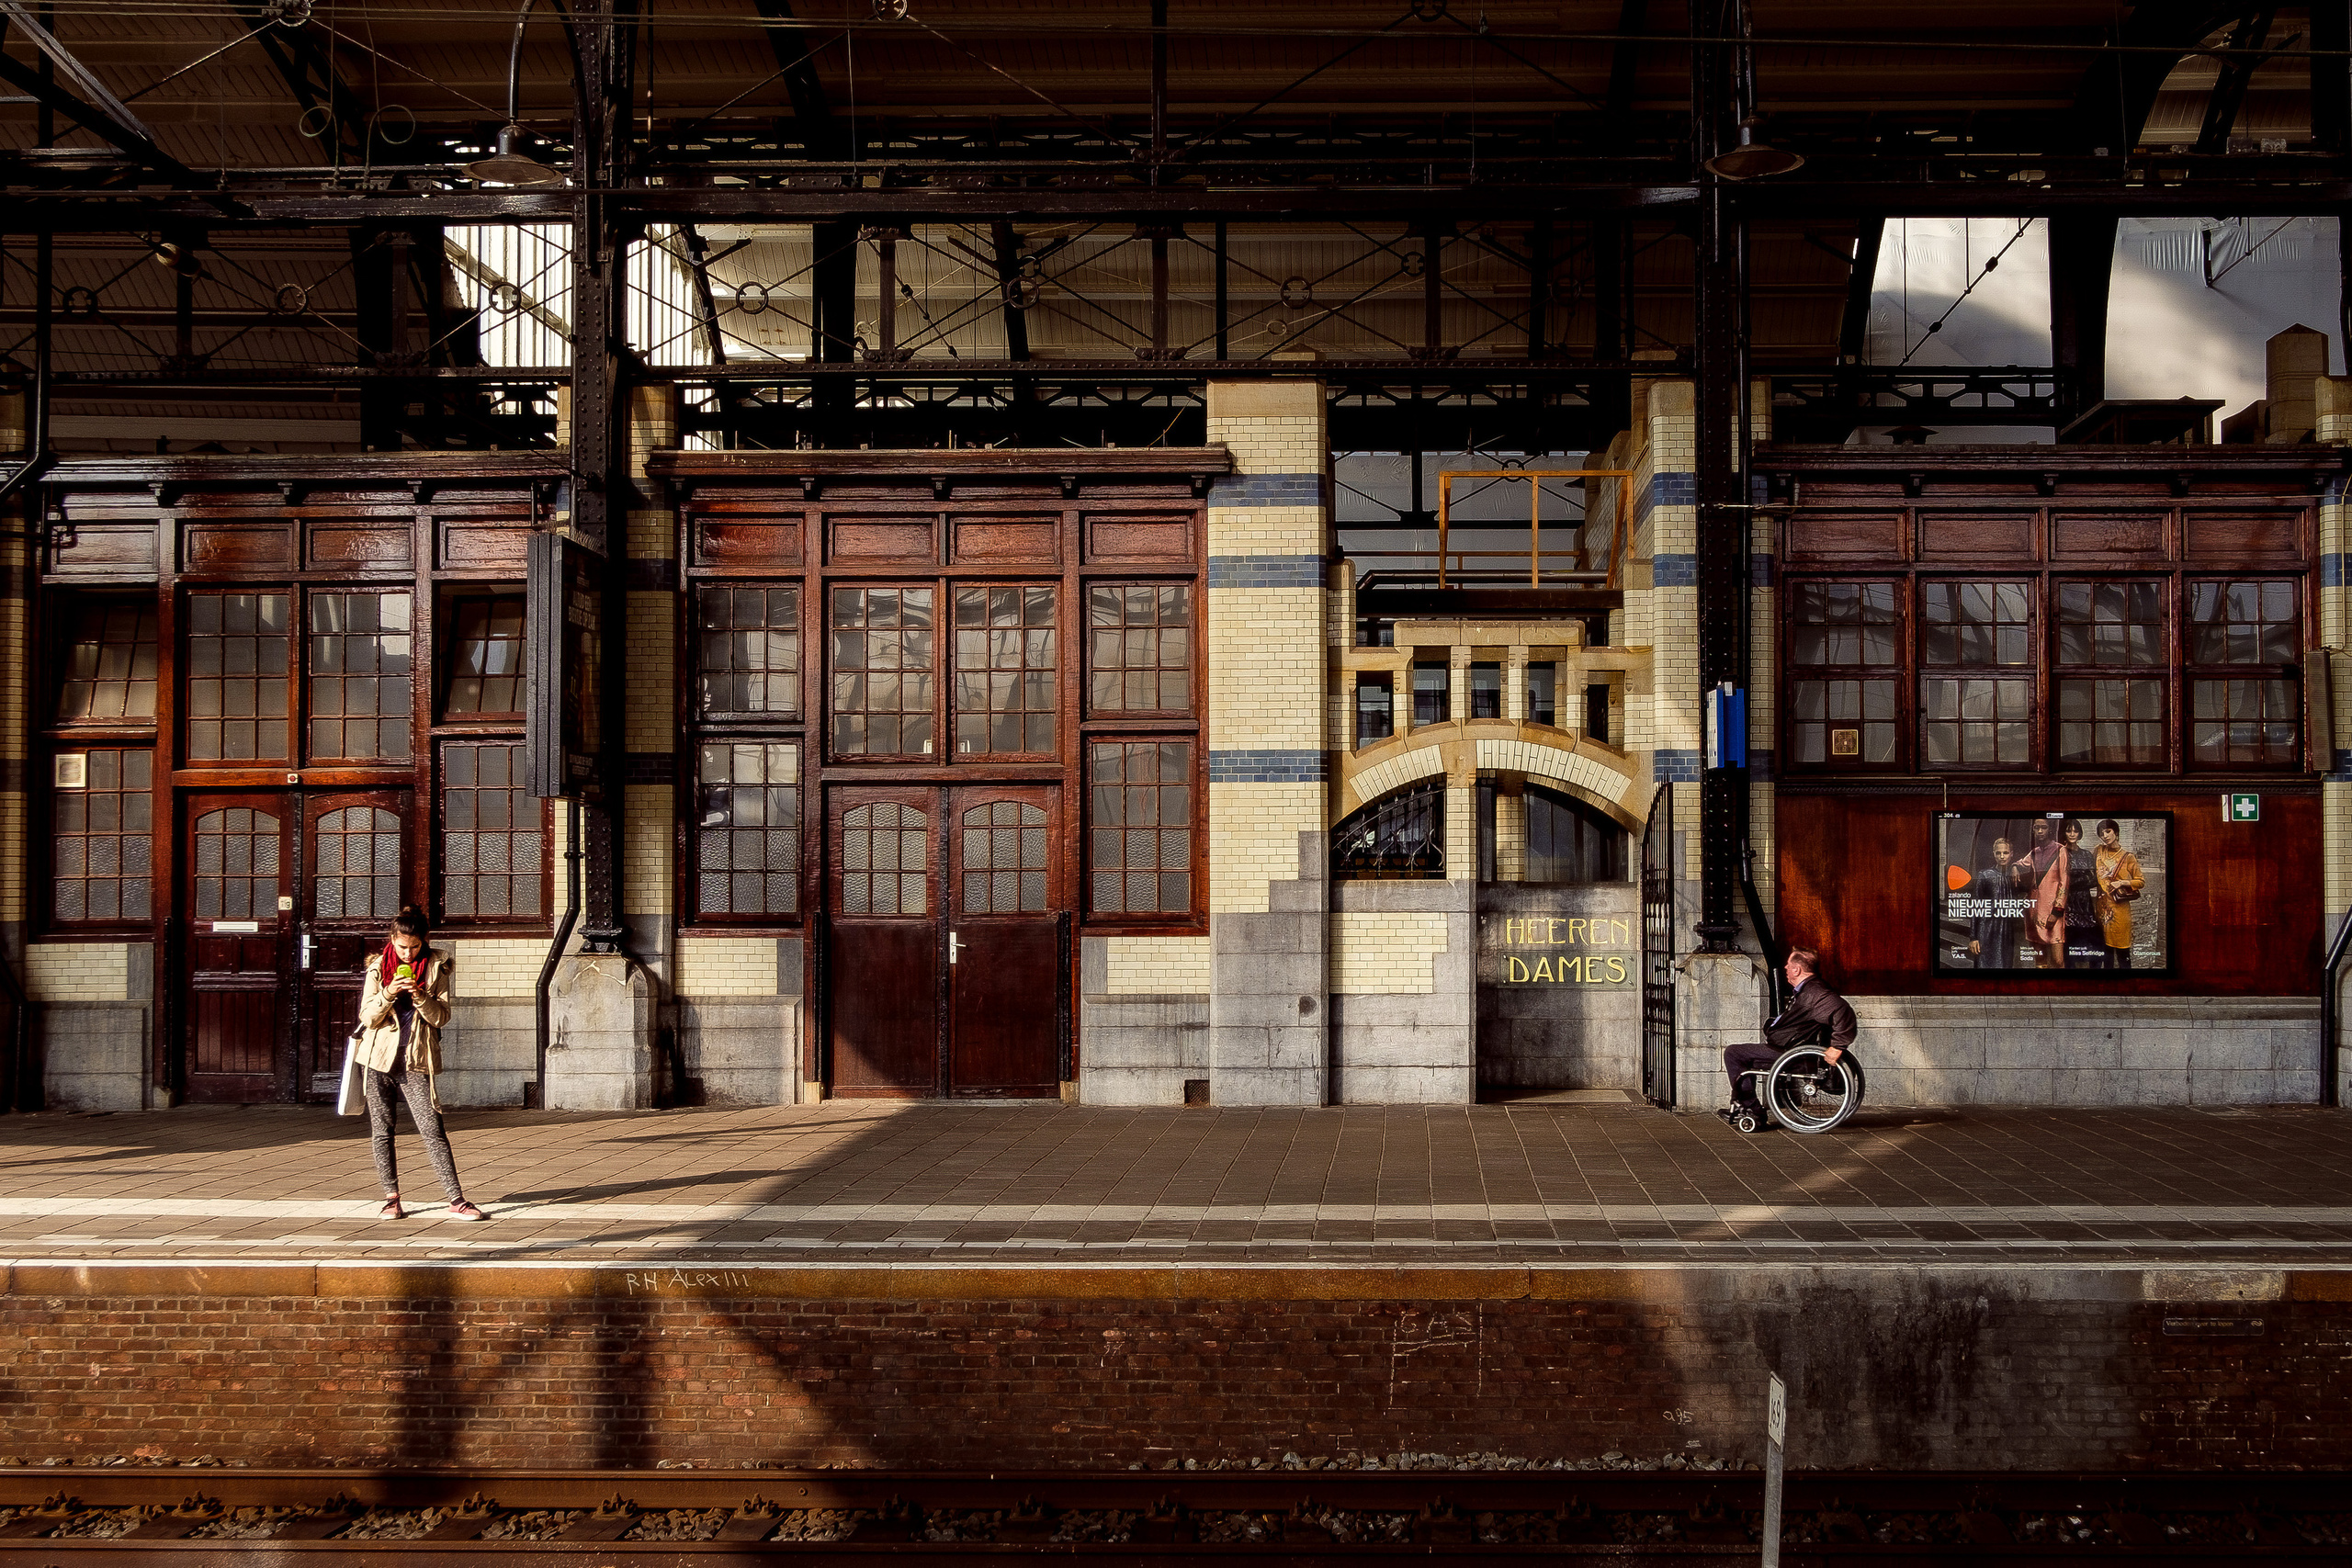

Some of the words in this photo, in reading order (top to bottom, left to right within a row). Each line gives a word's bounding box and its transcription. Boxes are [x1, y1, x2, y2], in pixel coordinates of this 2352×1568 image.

[1949, 899, 1991, 908] NIEUWE
[1994, 899, 2037, 908] HERFST
[1949, 908, 1991, 918] NIEUWE
[1994, 908, 2024, 918] JURK
[1506, 918, 1629, 946] HEEREN
[1509, 956, 1627, 983] DAMES
